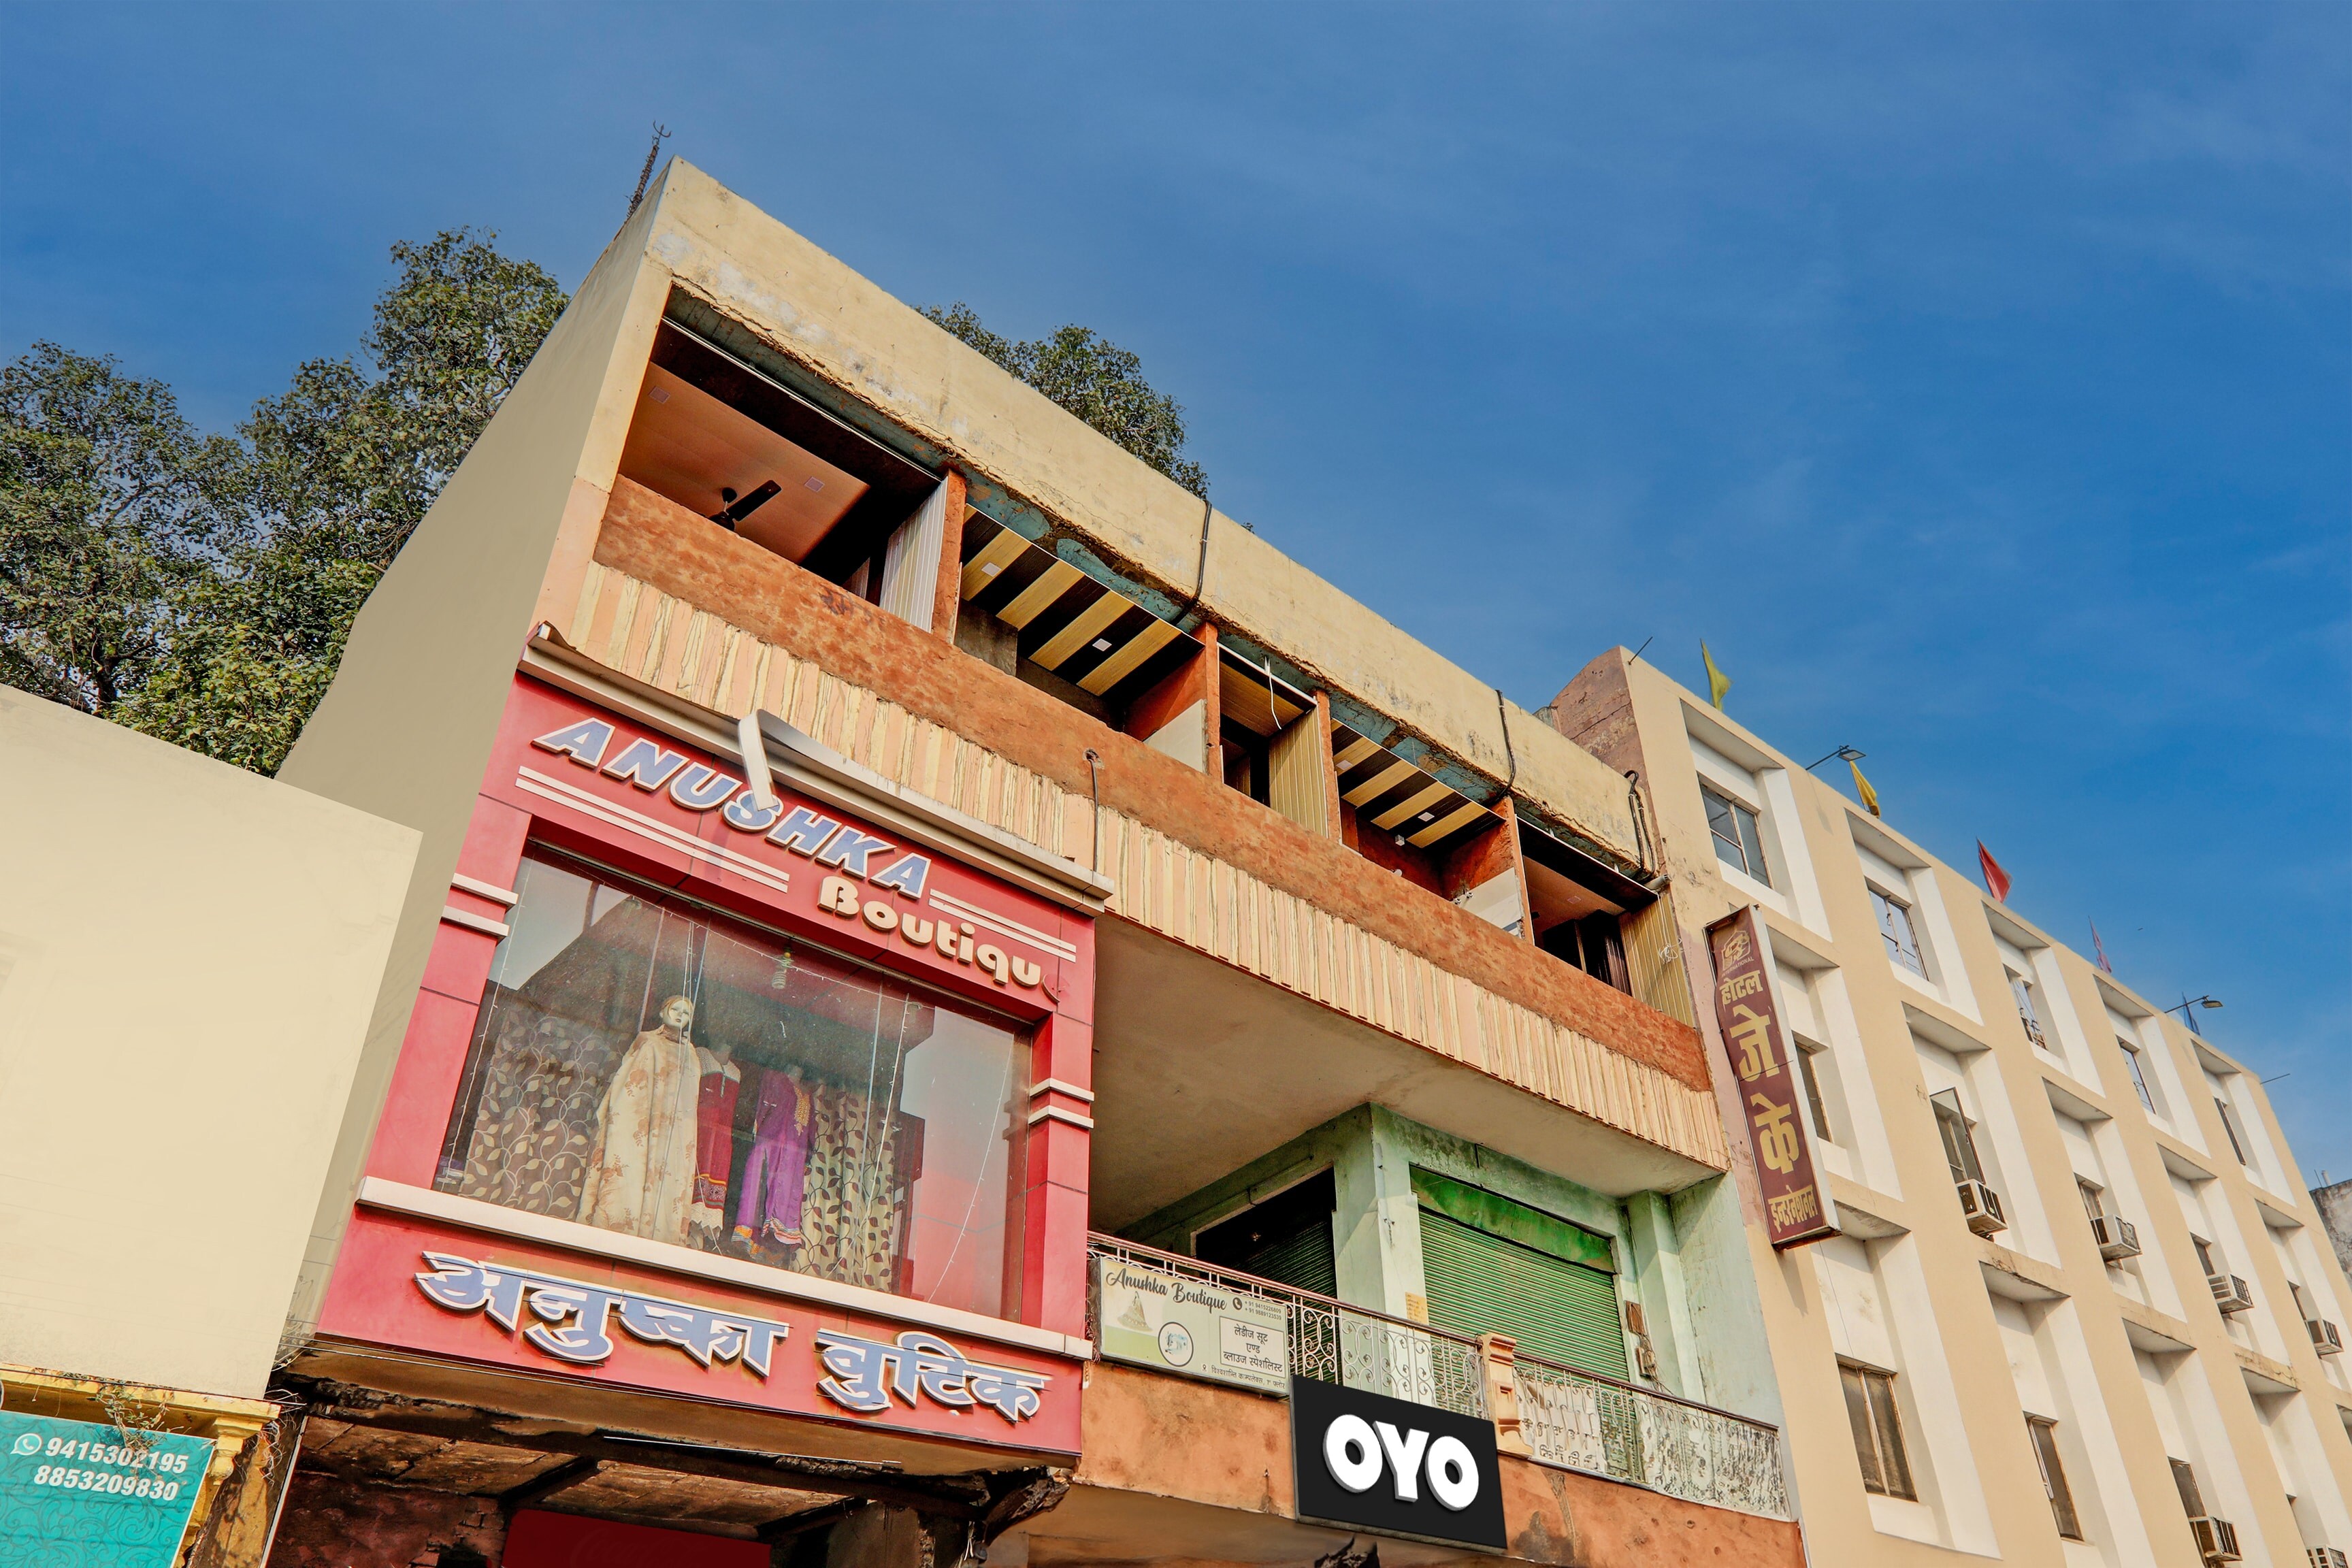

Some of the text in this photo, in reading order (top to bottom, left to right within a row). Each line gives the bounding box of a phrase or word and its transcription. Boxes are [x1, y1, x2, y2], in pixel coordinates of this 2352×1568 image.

[532, 717, 932, 900] ANUSHKA
[817, 876, 1060, 1004] Boutiqu
[1719, 970, 1763, 1004] होटल
[1731, 1004, 1780, 1083] जे
[1750, 1092, 1800, 1175] के
[414, 1250, 790, 1377] अनुष्का
[1171, 1282, 1227, 1313] Boutique
[1234, 1324, 1268, 1345] लेडीज सूट
[1246, 1343, 1260, 1354] एण्ड
[34, 1465, 179, 1501] 8853209830
[45, 1437, 189, 1473] 9415302195
[1322, 1414, 1479, 1511] OYO
